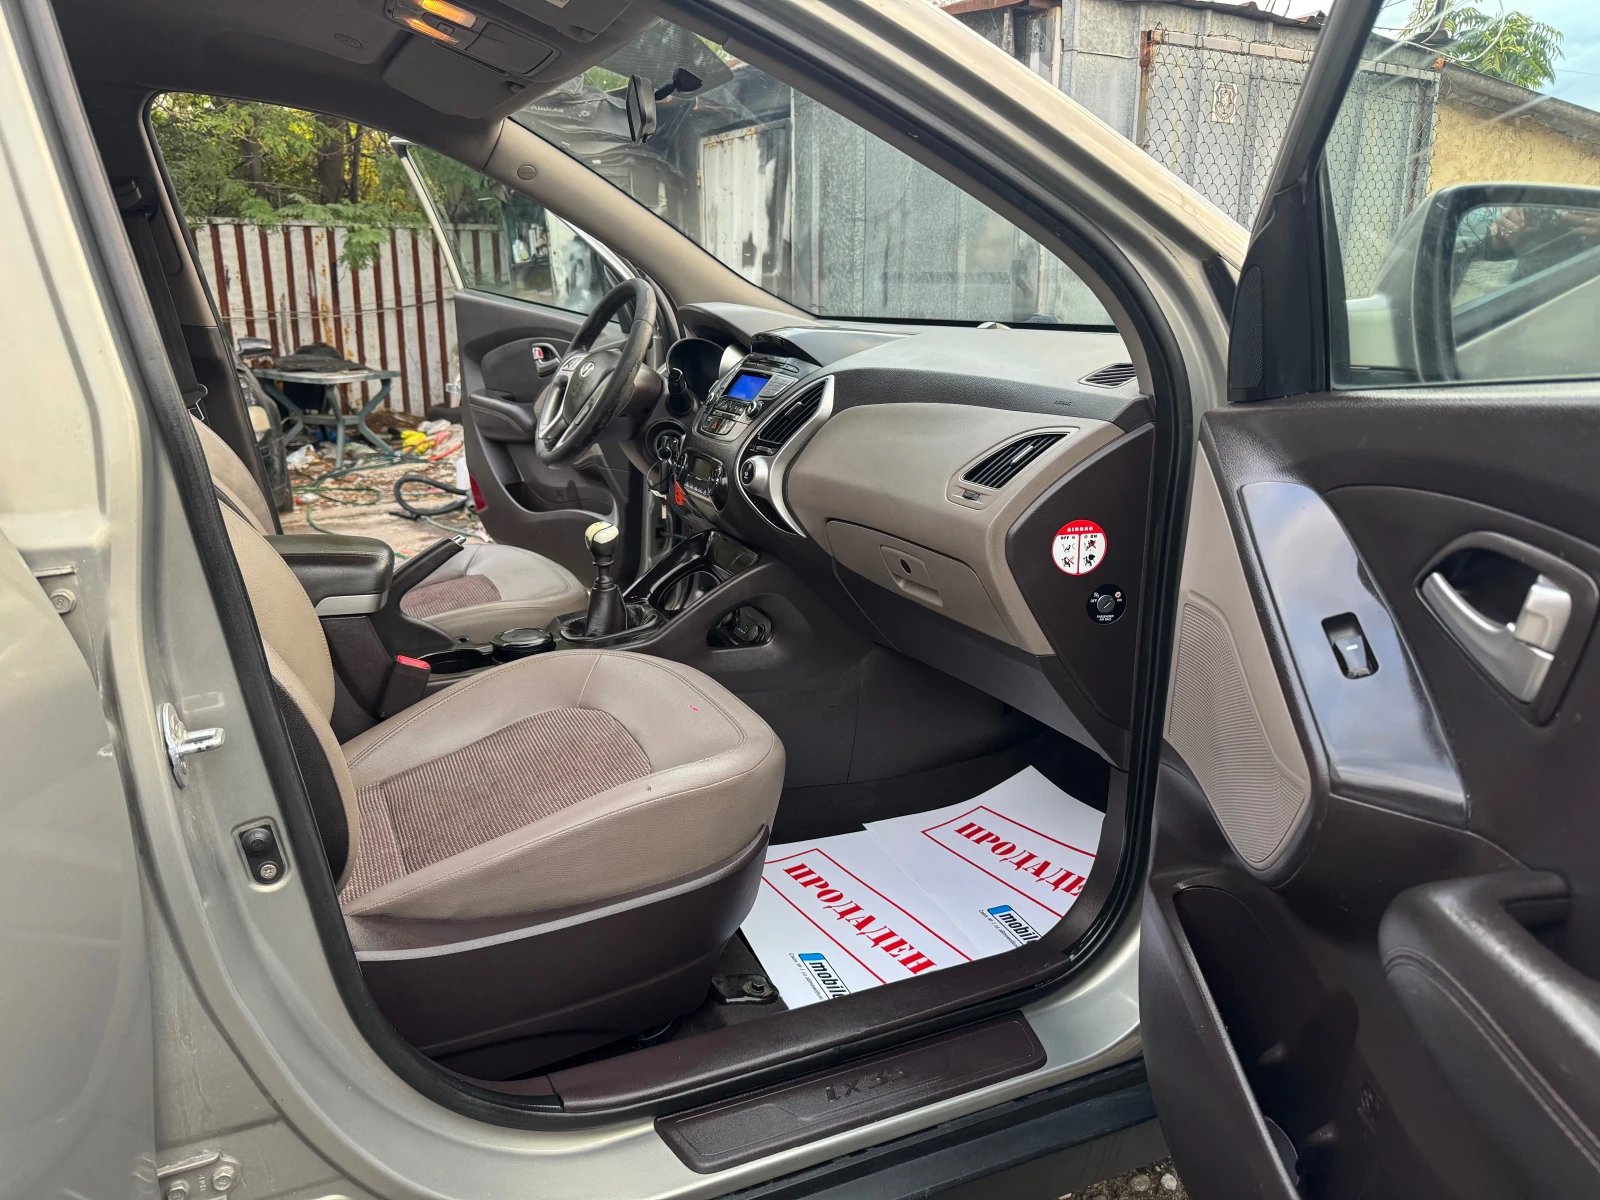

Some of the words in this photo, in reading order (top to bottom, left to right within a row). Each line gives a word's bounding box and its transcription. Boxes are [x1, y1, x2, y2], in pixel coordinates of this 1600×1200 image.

[954, 822, 1086, 896] ПРОДАДЕ
[783, 863, 937, 975] ПРОДАДЕН
[998, 912, 1039, 943] mobil
